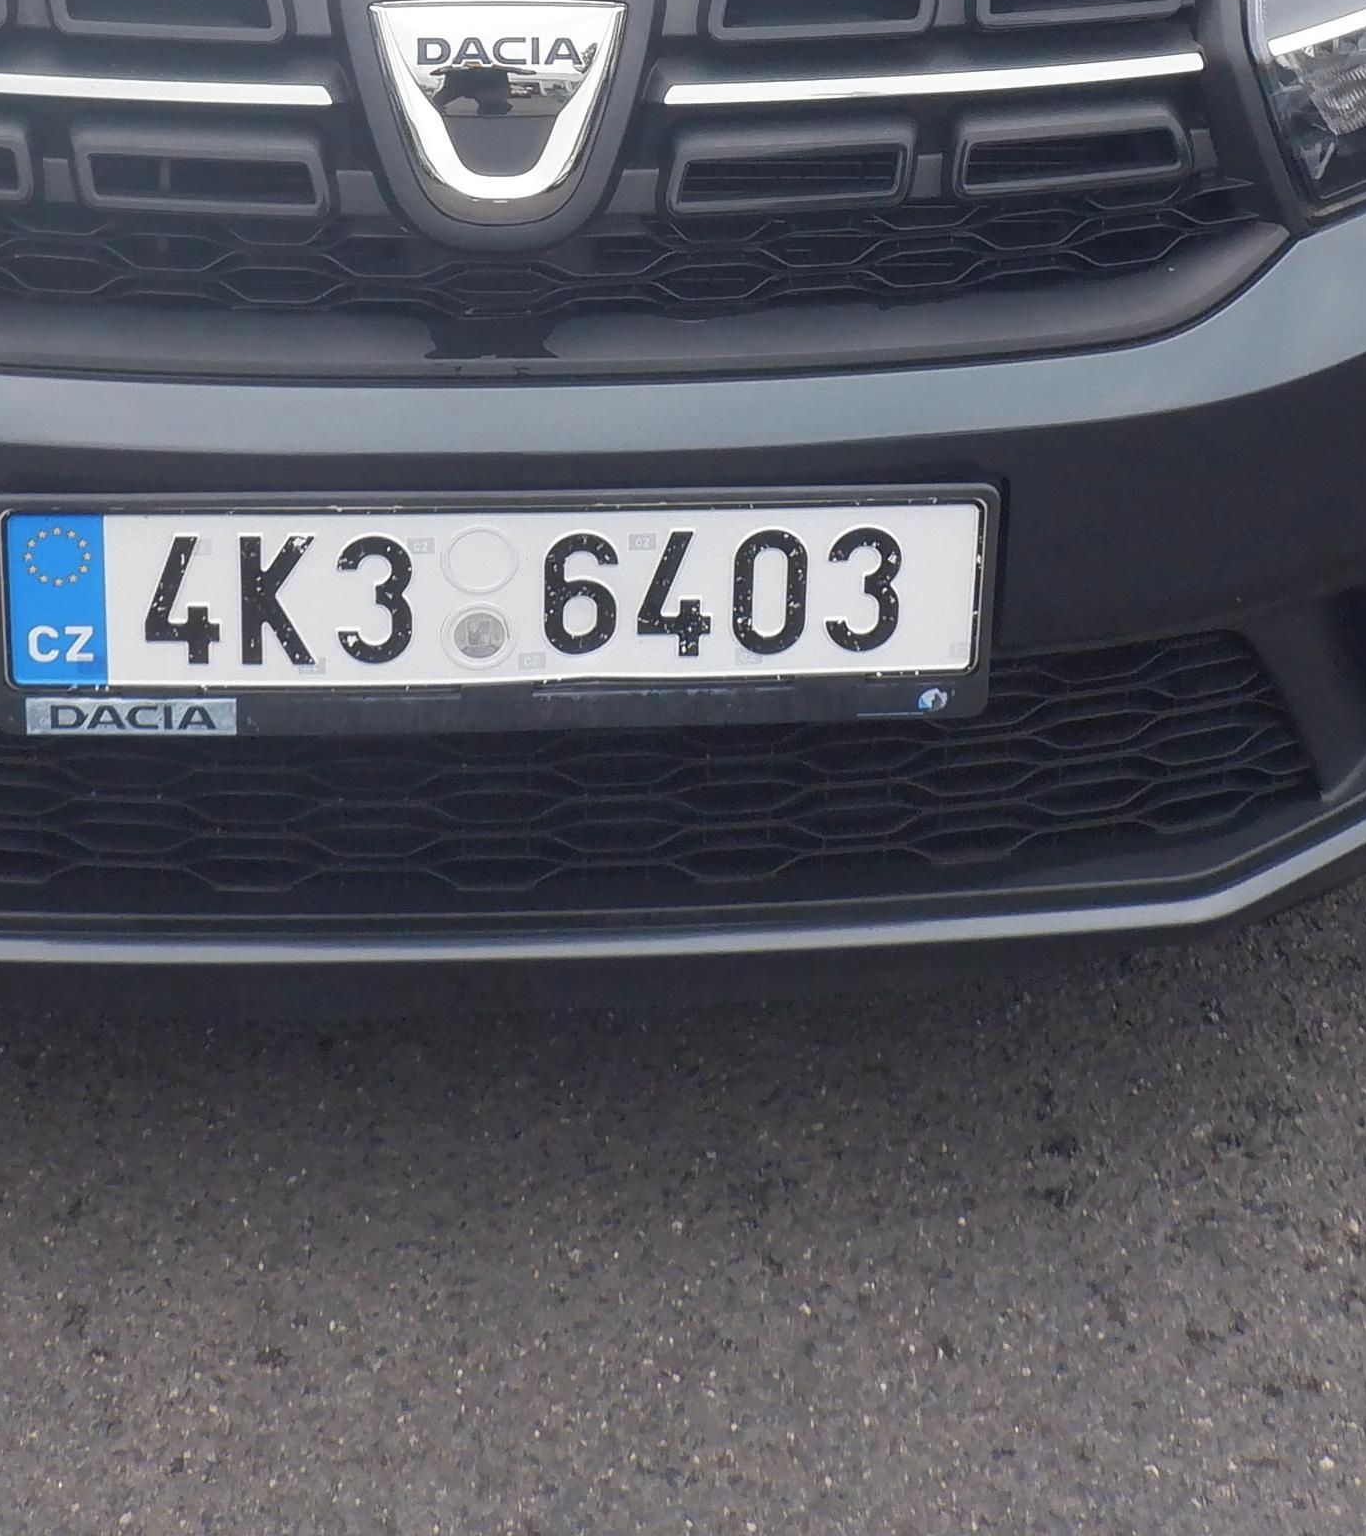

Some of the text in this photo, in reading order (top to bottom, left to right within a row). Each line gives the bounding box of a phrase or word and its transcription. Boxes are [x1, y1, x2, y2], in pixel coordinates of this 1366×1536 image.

[416, 36, 584, 66] DACIA
[144, 525, 903, 666] 4K3 6403
[27, 624, 95, 664] CZ
[50, 704, 218, 731] DACIA
